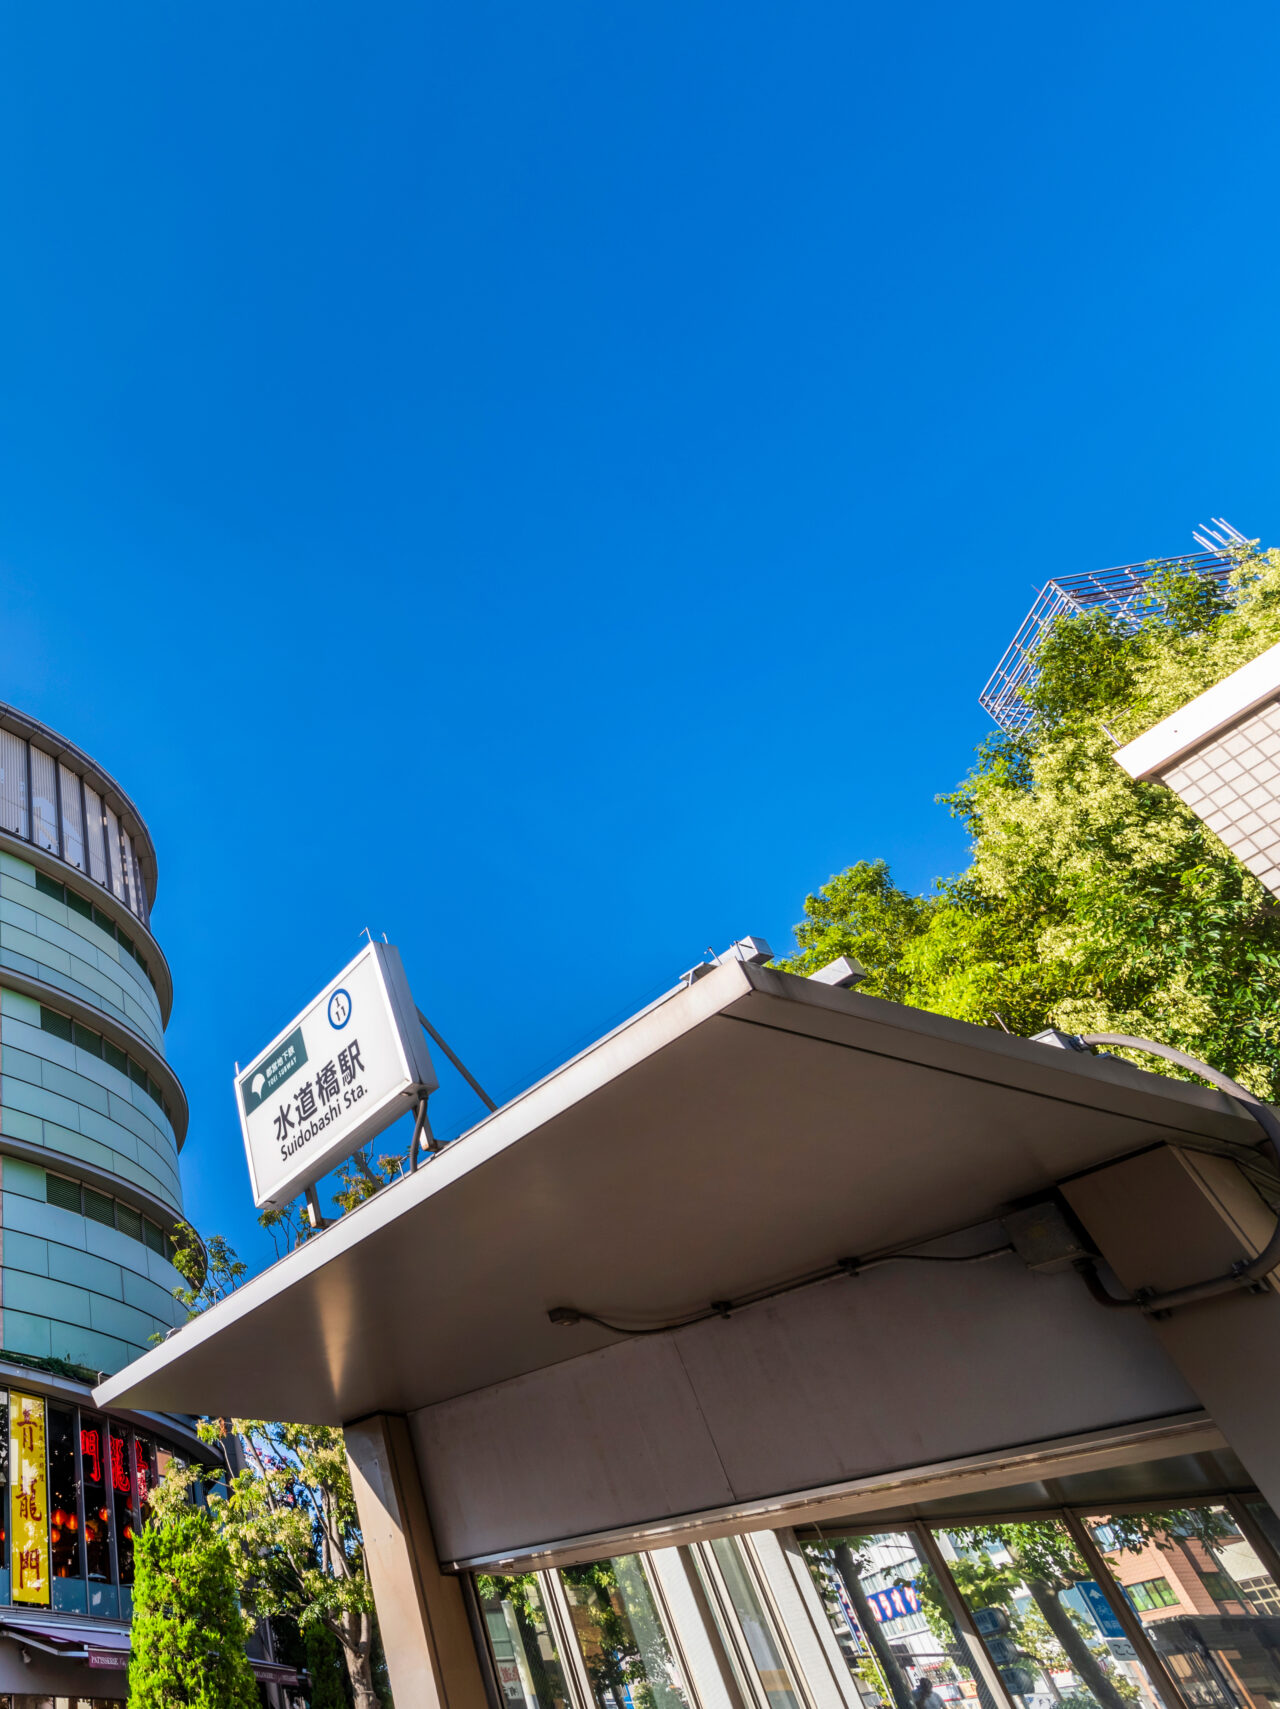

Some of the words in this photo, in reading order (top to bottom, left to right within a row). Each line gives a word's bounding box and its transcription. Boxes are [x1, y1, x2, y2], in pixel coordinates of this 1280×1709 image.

[273, 1039, 365, 1142] 水道橋駅
[278, 1056, 297, 1078] SUBWAY
[280, 1098, 342, 1162] Suidobashi
[344, 1084, 368, 1110] Sta.
